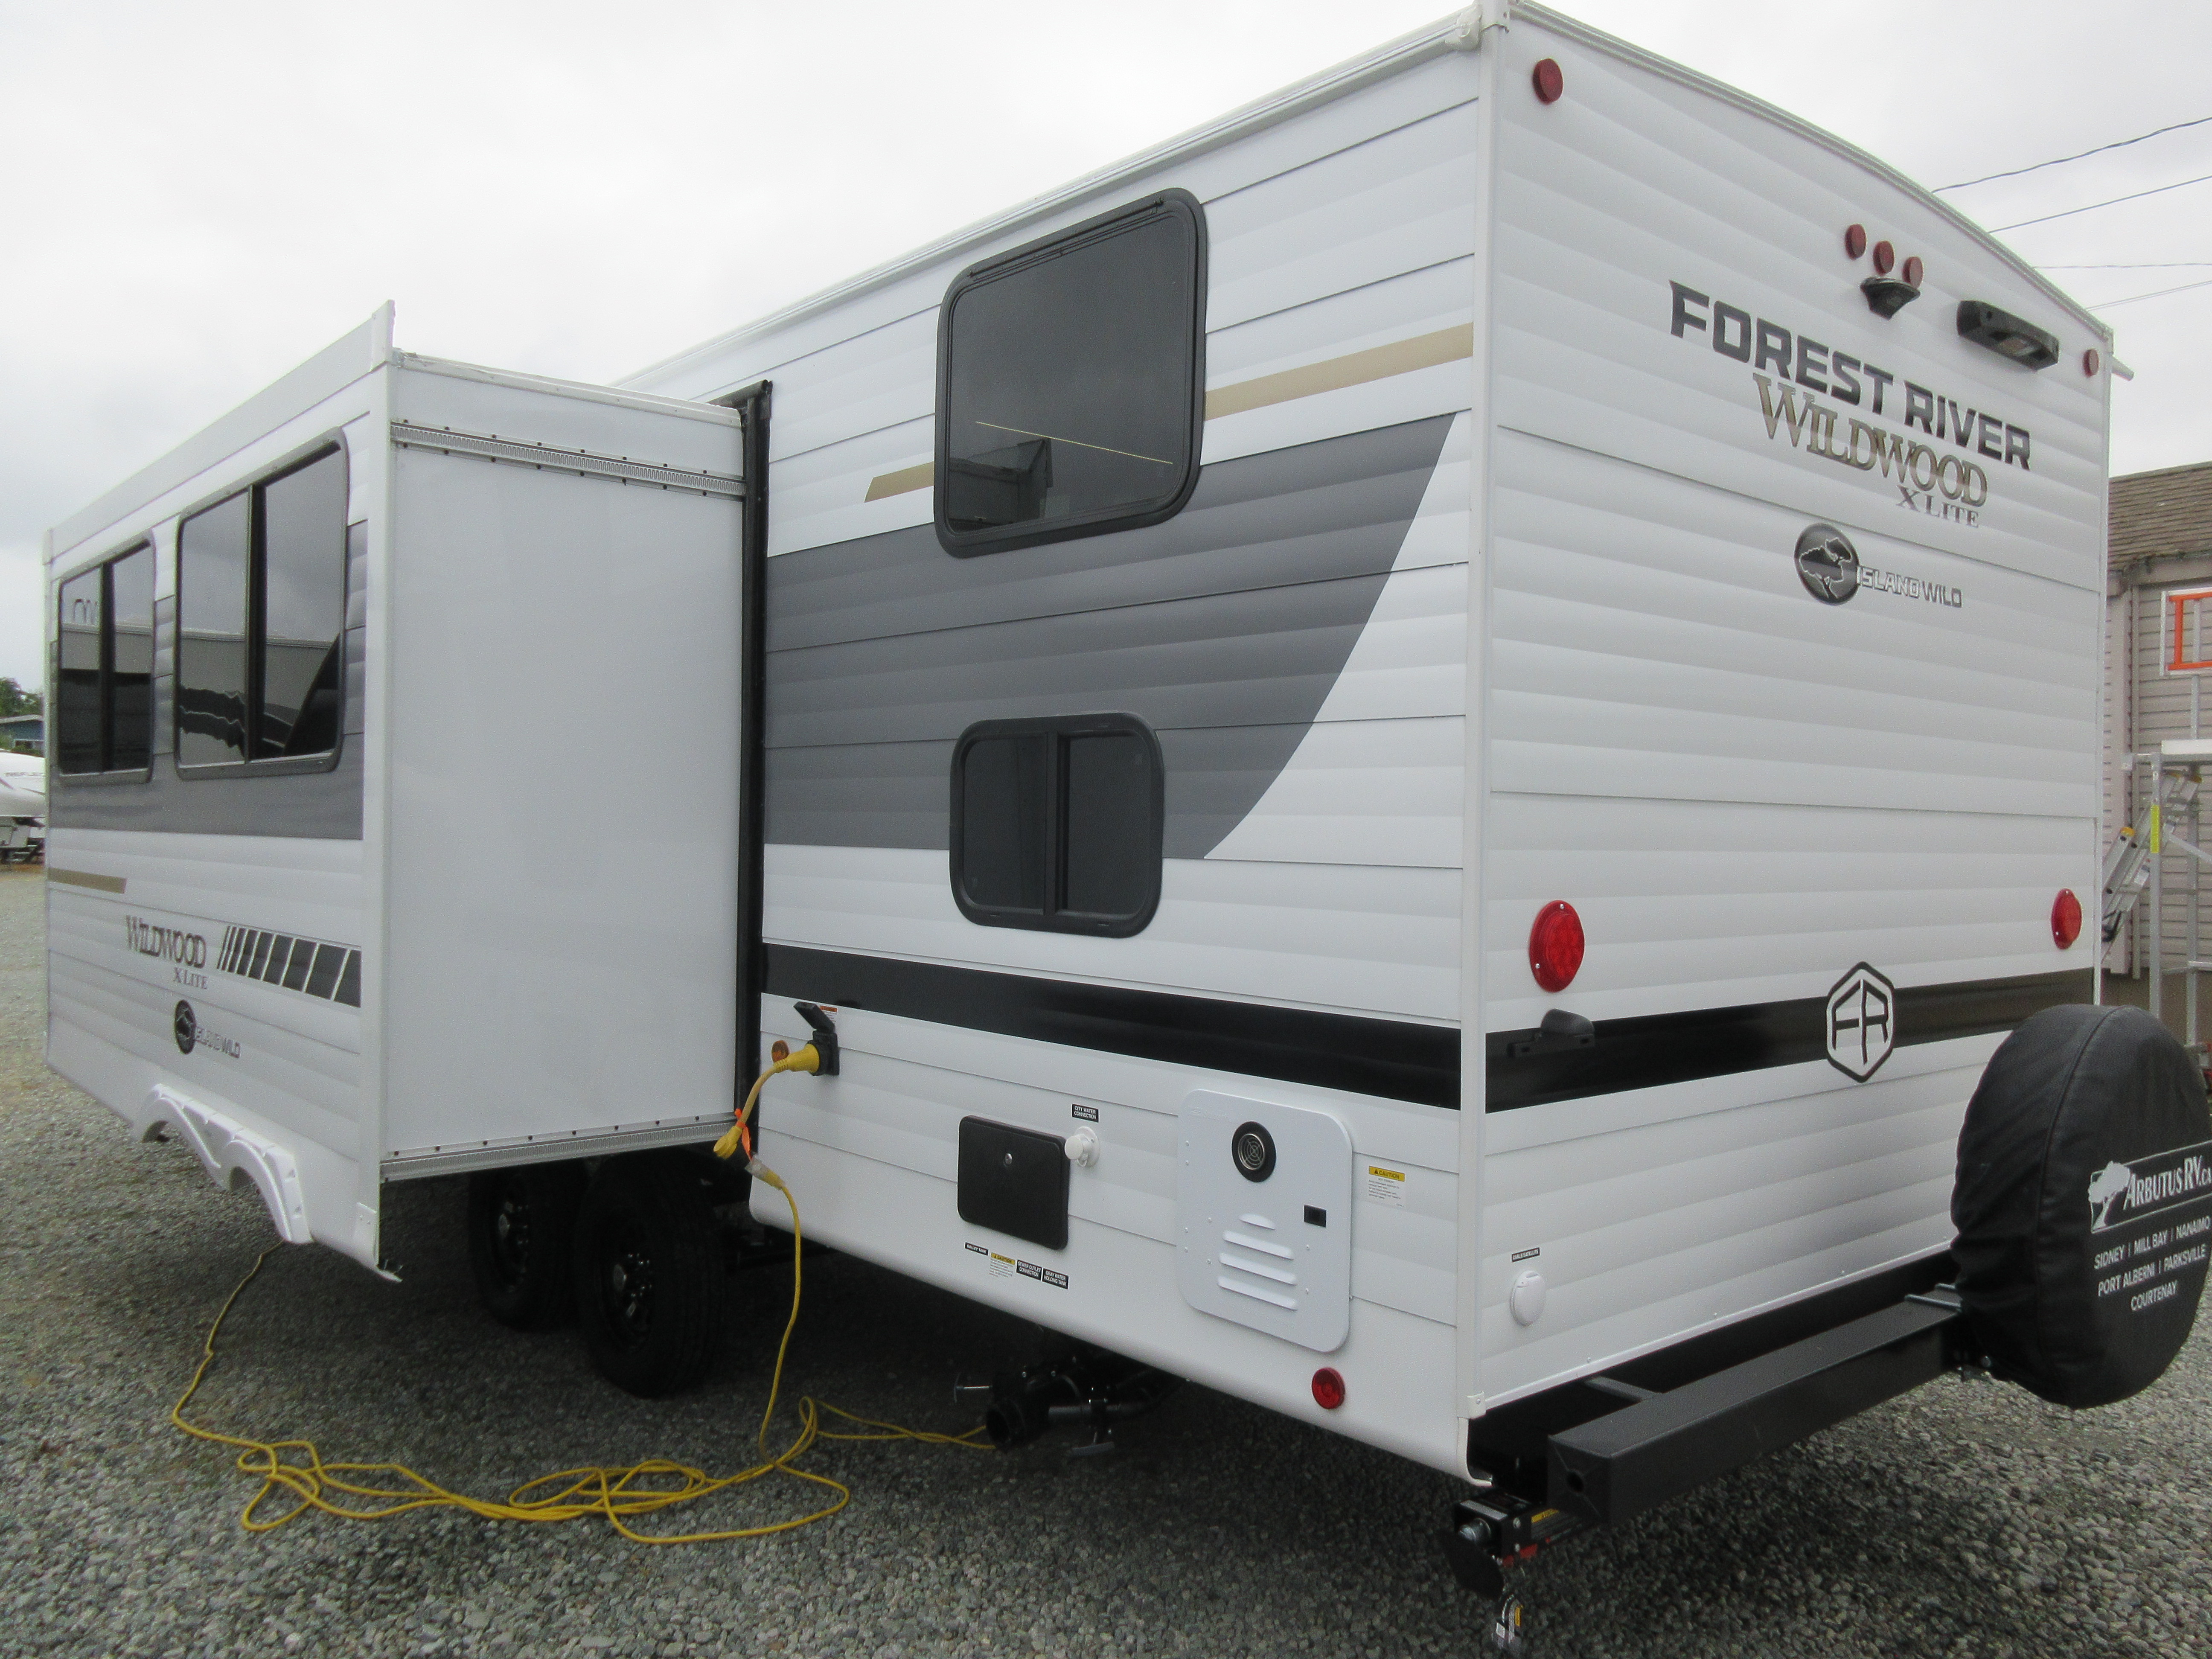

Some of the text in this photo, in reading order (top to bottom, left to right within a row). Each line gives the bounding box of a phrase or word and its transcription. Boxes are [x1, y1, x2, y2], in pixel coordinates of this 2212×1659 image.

[1669, 280, 2031, 470] FOREST RIVER
[1753, 373, 1987, 507] WILDWOOD
[126, 915, 207, 969] WILDWOOD
[1074, 1111, 1096, 1119] CONNECTION
[1379, 1170, 1400, 1179] CAUTION
[2094, 1216, 2211, 1269] SIDNEY MILL BAY NANAIMO
[2098, 1243, 2206, 1296] PORT ALBERNI PARKSVILLE
[2131, 1280, 2177, 1311] COURTENAY
